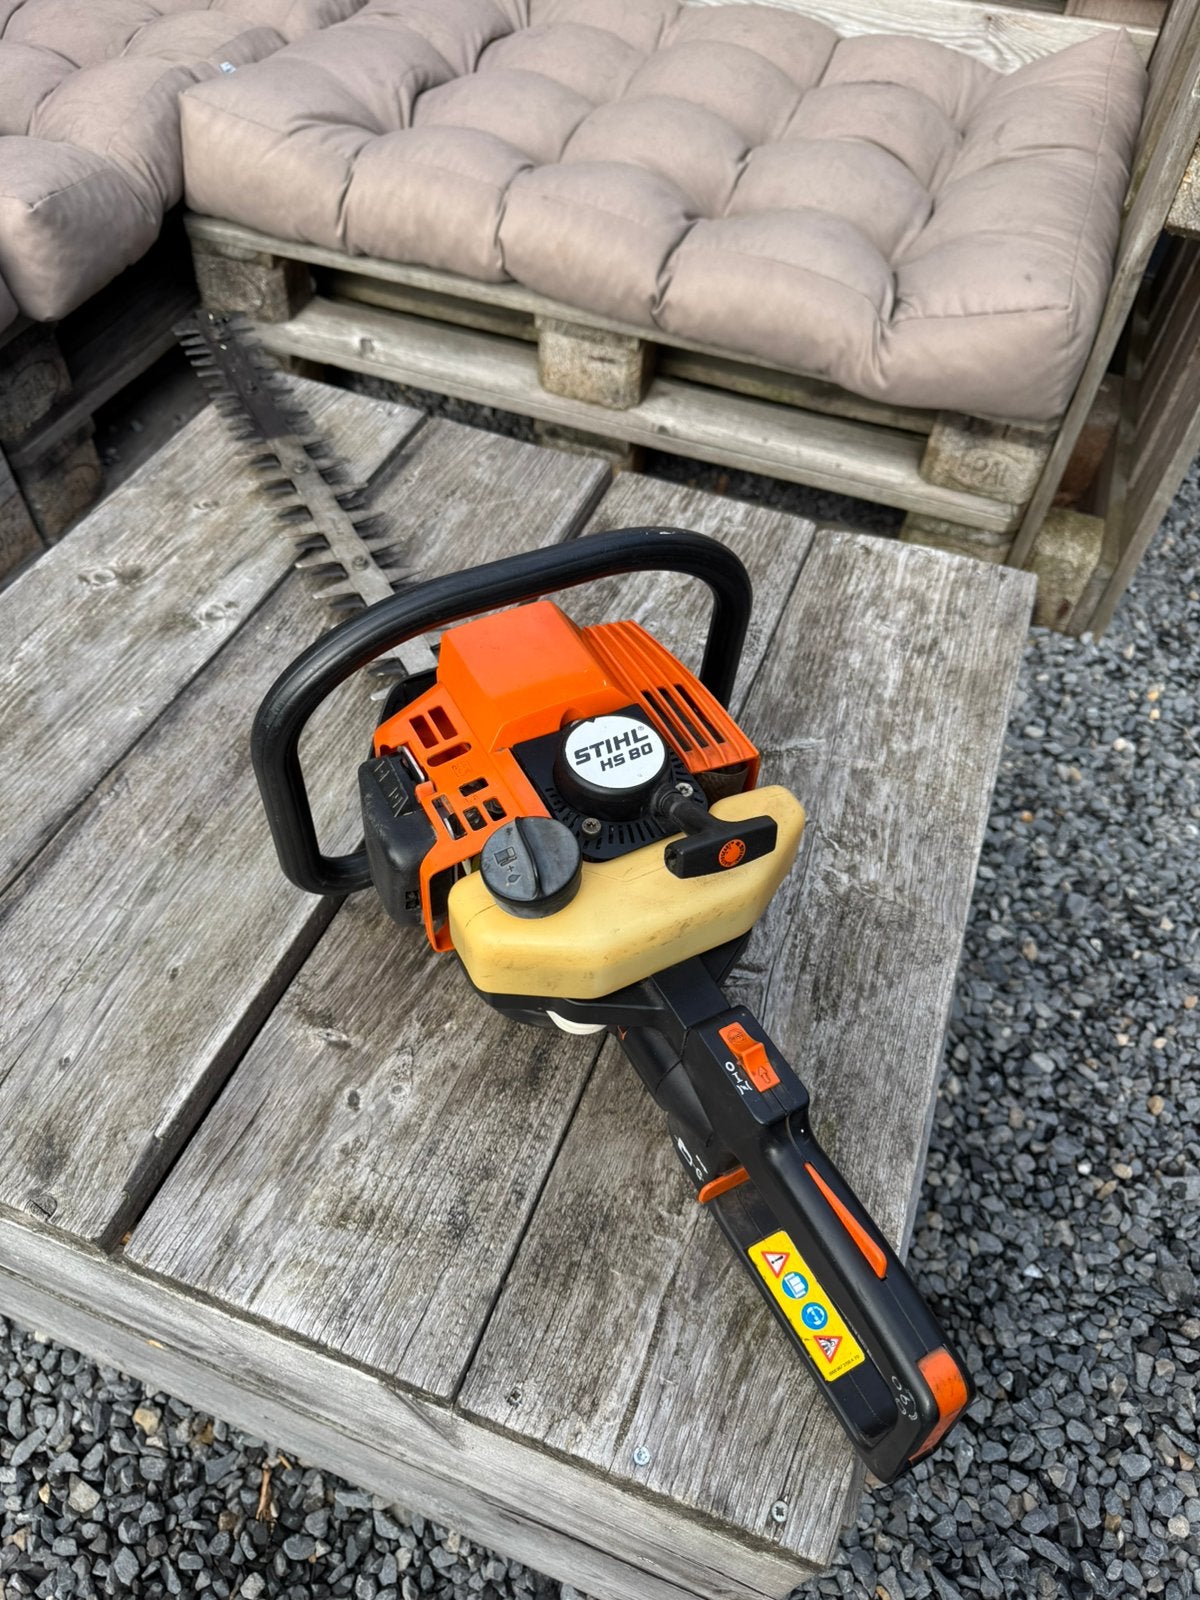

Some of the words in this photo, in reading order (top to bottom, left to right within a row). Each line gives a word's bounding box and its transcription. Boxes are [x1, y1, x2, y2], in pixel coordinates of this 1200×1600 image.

[574, 728, 649, 766] STIHL
[600, 753, 626, 772] HS
[628, 742, 653, 761] 80
